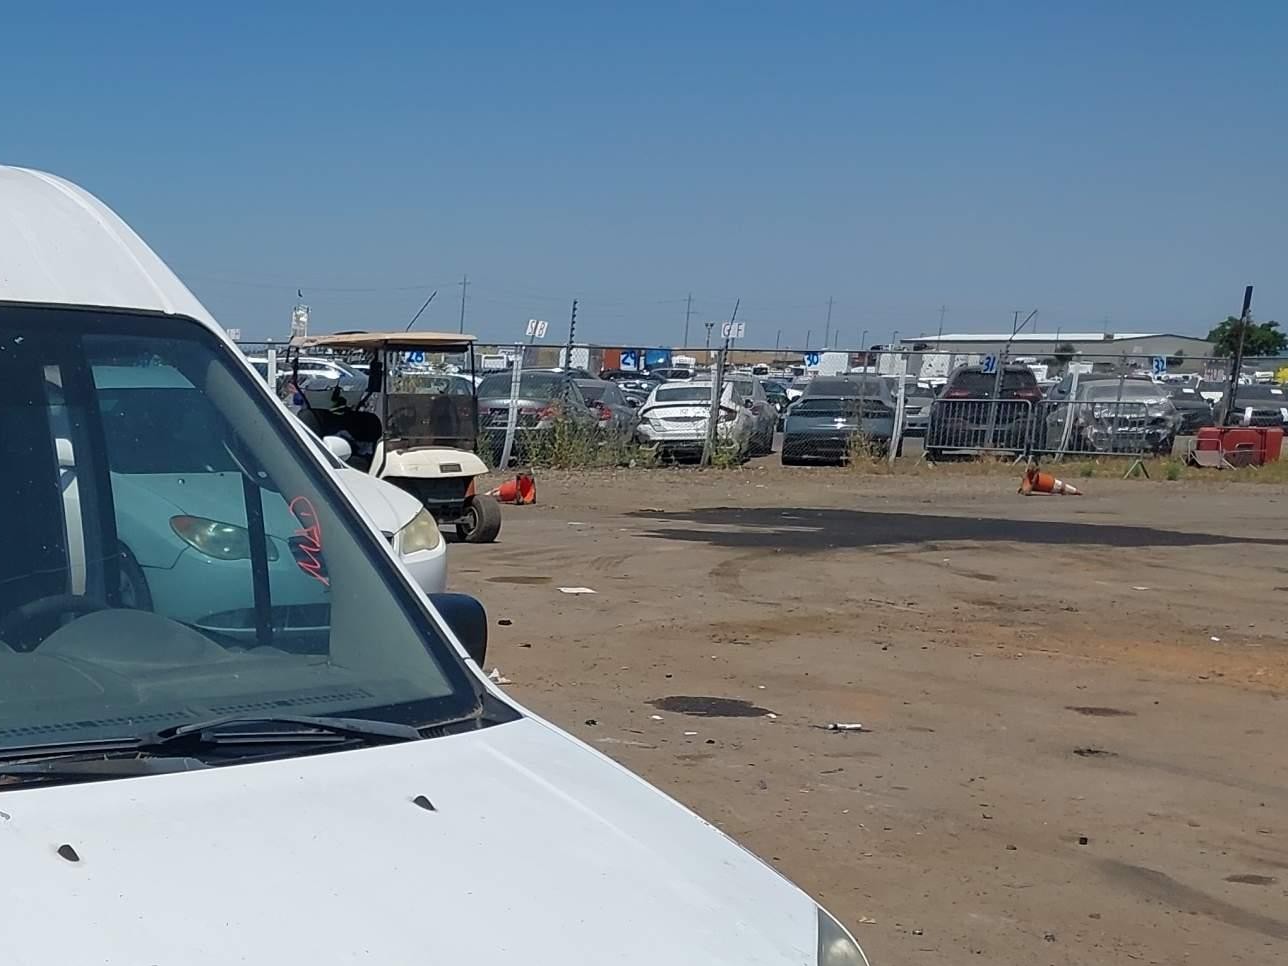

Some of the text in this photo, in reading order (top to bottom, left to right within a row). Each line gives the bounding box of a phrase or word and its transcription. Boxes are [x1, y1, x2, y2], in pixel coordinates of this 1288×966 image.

[621, 350, 637, 368] 29
[805, 352, 819, 367] 30
[983, 356, 996, 372] 31
[1154, 358, 1167, 374] 32
